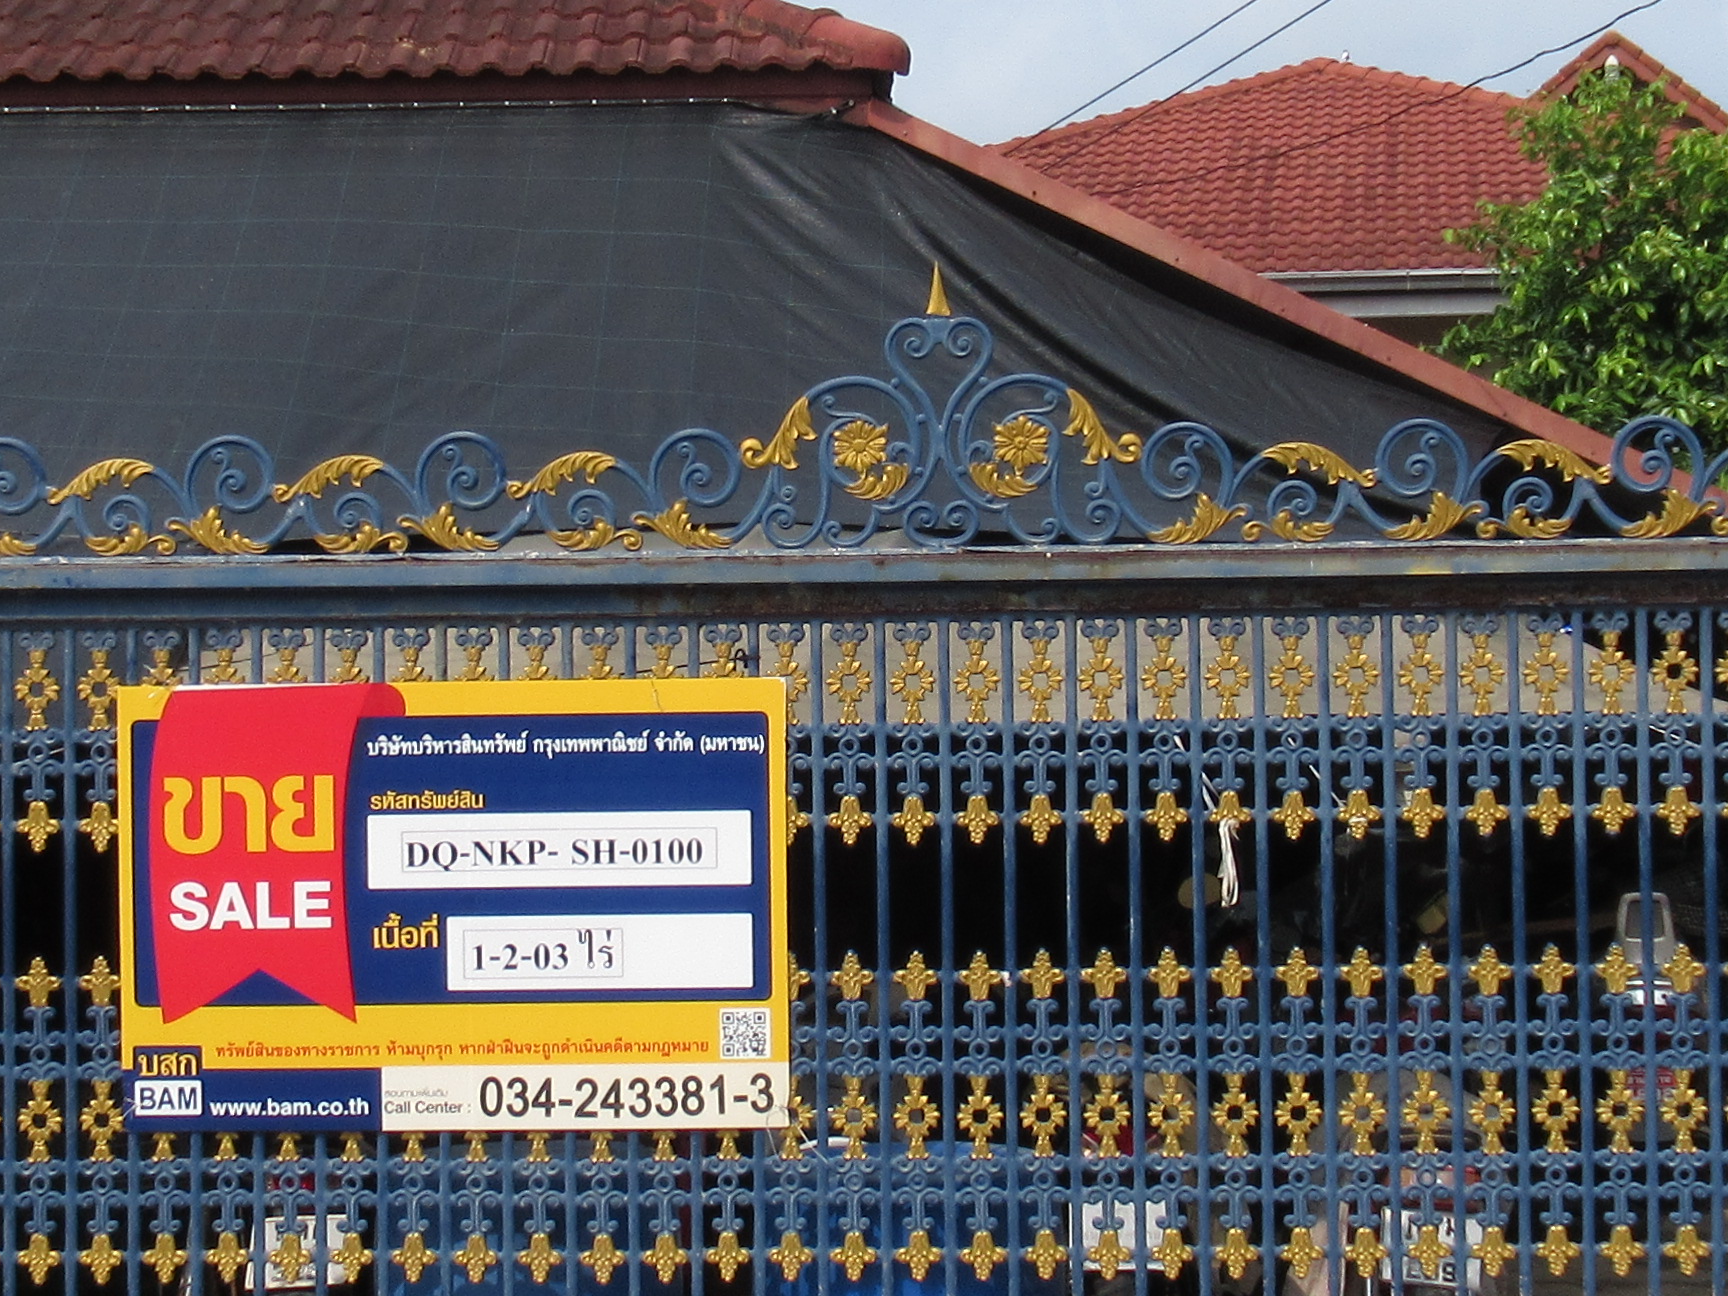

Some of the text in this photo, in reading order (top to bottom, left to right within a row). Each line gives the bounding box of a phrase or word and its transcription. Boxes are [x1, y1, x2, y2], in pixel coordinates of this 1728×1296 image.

[367, 729, 765, 759] บริษัทบริหารสินทรัพย์ กรุงเทพพาณิชย์ จำกัด (มหาชน)
[370, 788, 485, 810] รหัสทรัพย์สิน
[163, 775, 335, 854] ขาย
[405, 837, 704, 872] DQ-NKP- SH-0100
[169, 880, 332, 932] SALE
[372, 913, 440, 950] เนื้อที่
[471, 929, 615, 972] 1-2-03 ไร่
[138, 1052, 198, 1077] บสก
[215, 1041, 380, 1059] ทรัพย์สินของทางราชการ
[386, 1039, 453, 1062] ห้ามบุกรุก
[138, 1086, 199, 1111] BAM
[209, 1097, 370, 1118] www.bam.co.th
[384, 1100, 411, 1115] Call
[414, 1100, 463, 1114] Center
[478, 1072, 773, 1119] 034-243381-3
